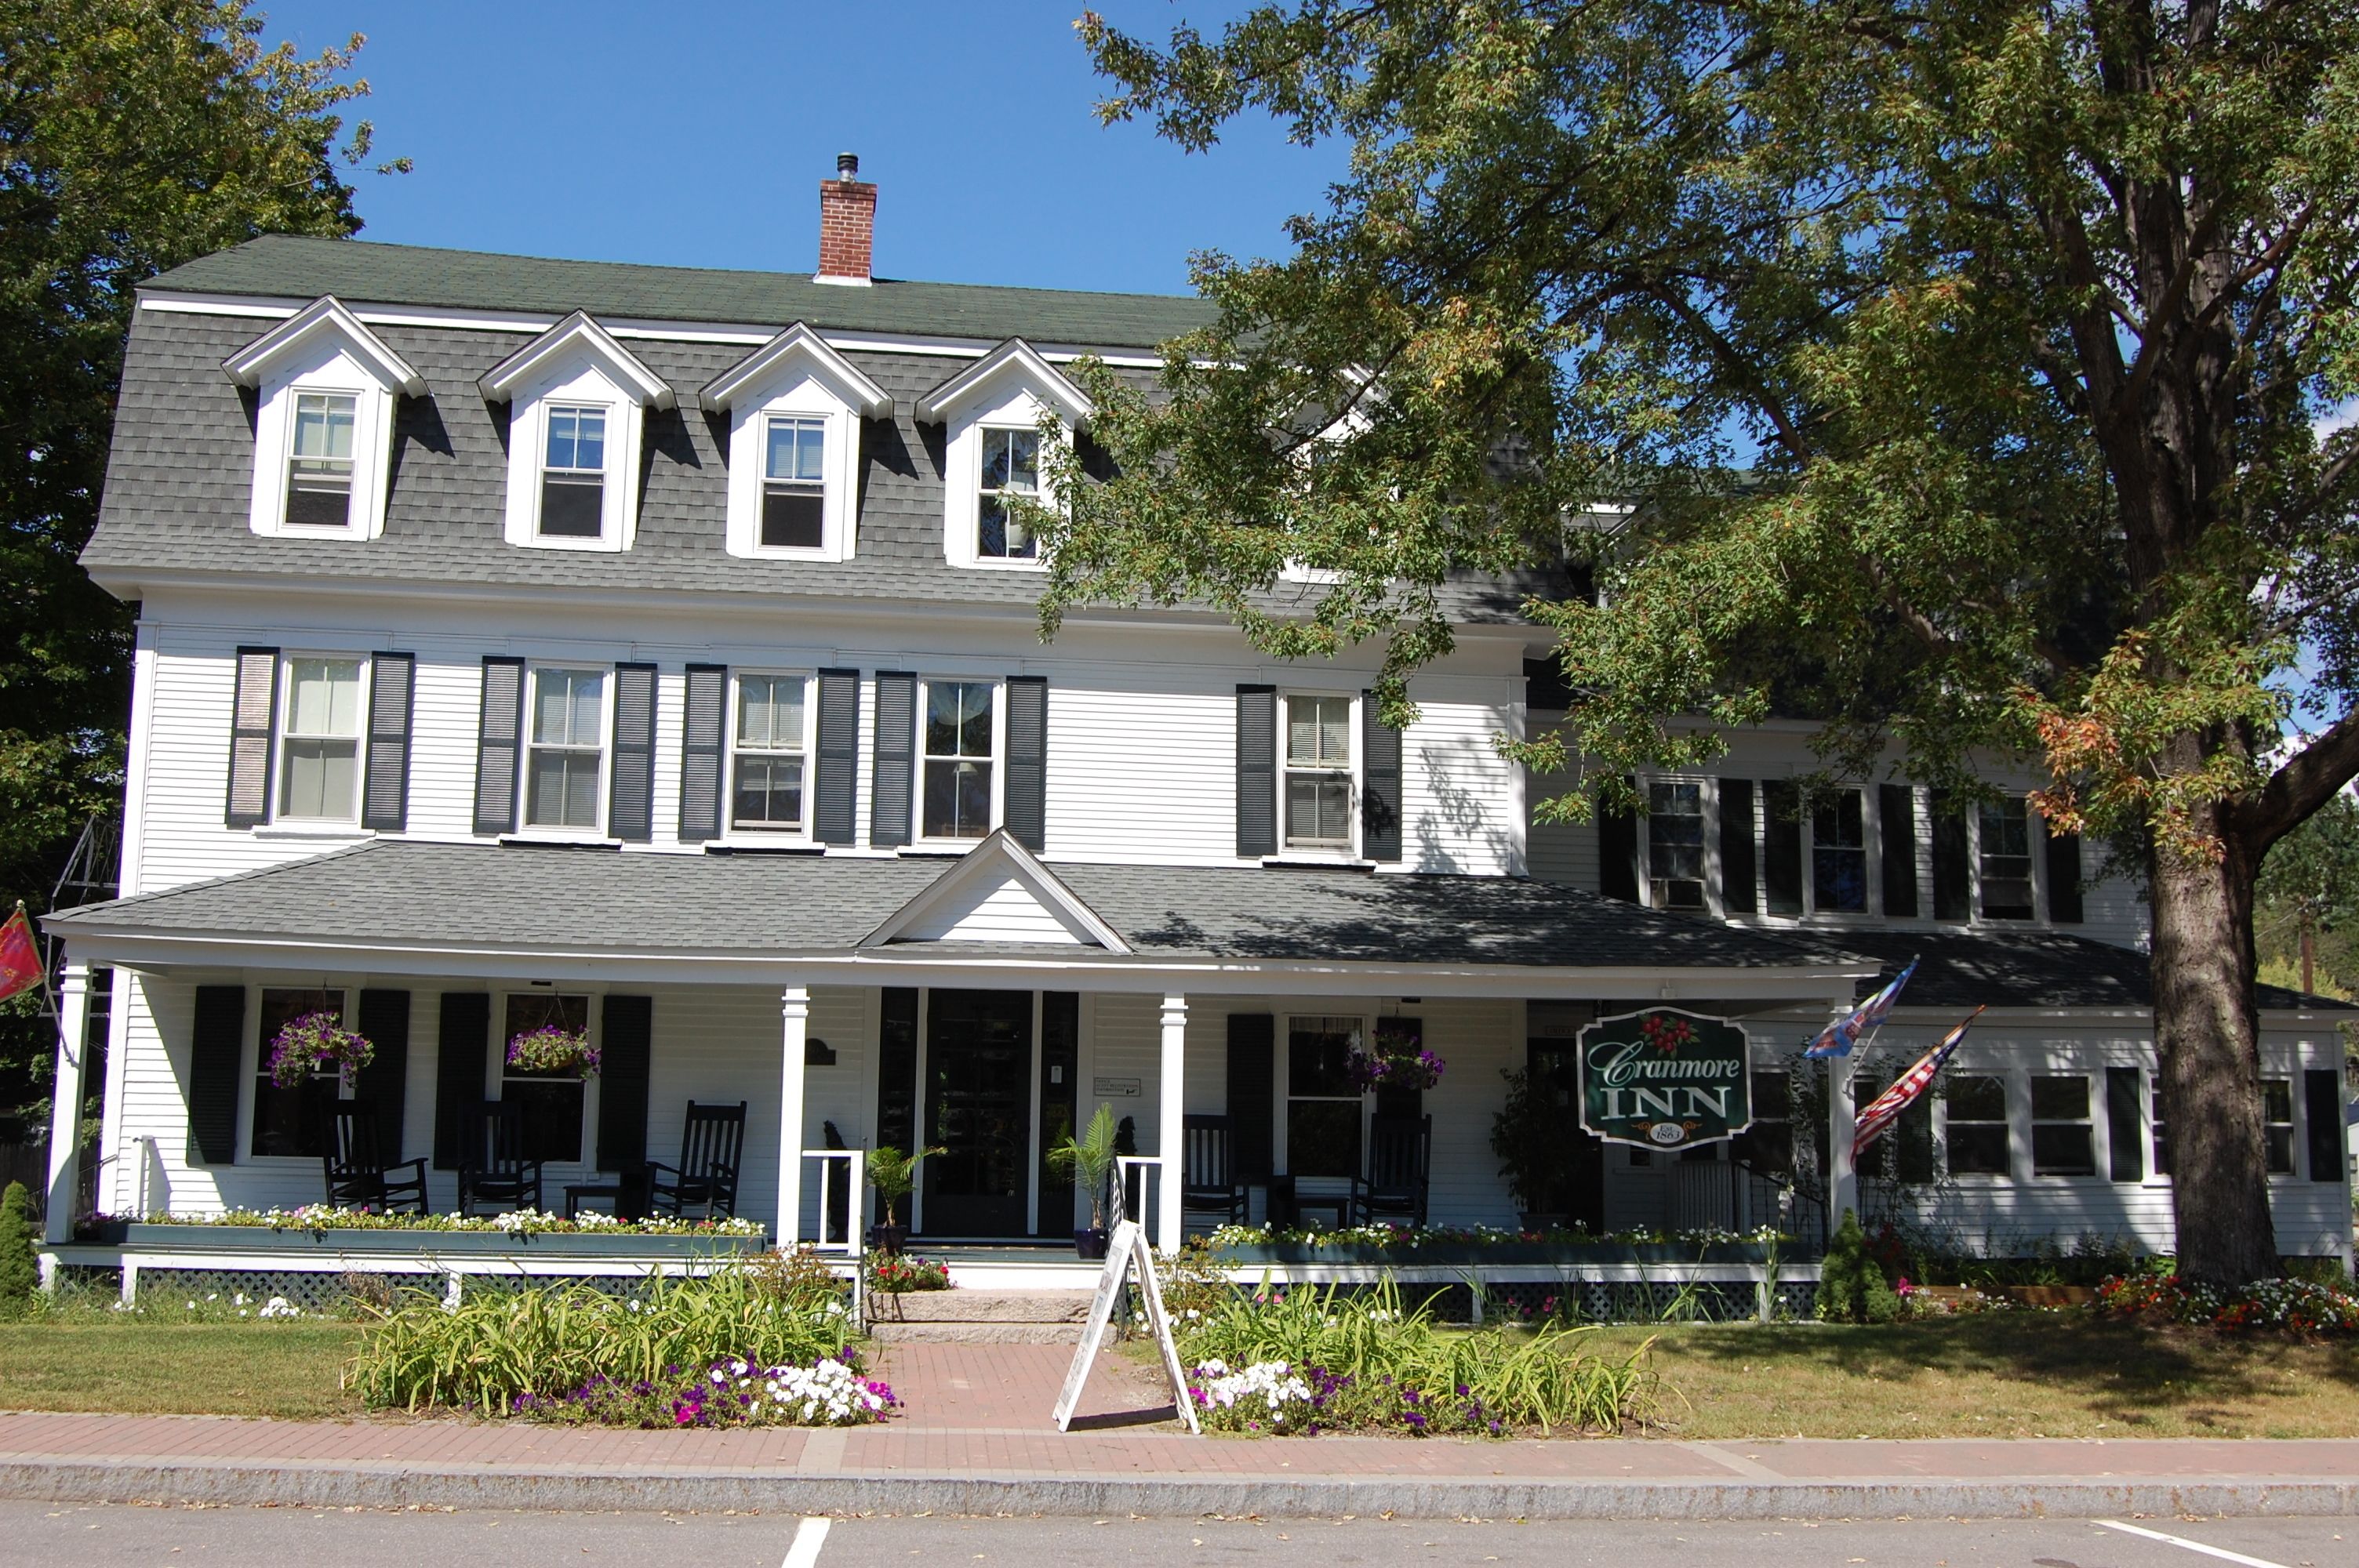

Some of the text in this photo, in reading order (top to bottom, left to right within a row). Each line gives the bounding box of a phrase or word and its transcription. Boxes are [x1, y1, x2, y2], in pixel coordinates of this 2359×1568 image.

[1587, 1040, 1740, 1087] Cranmore
[1600, 1086, 1732, 1120] INN
[1657, 1131, 1680, 1139] 1863
